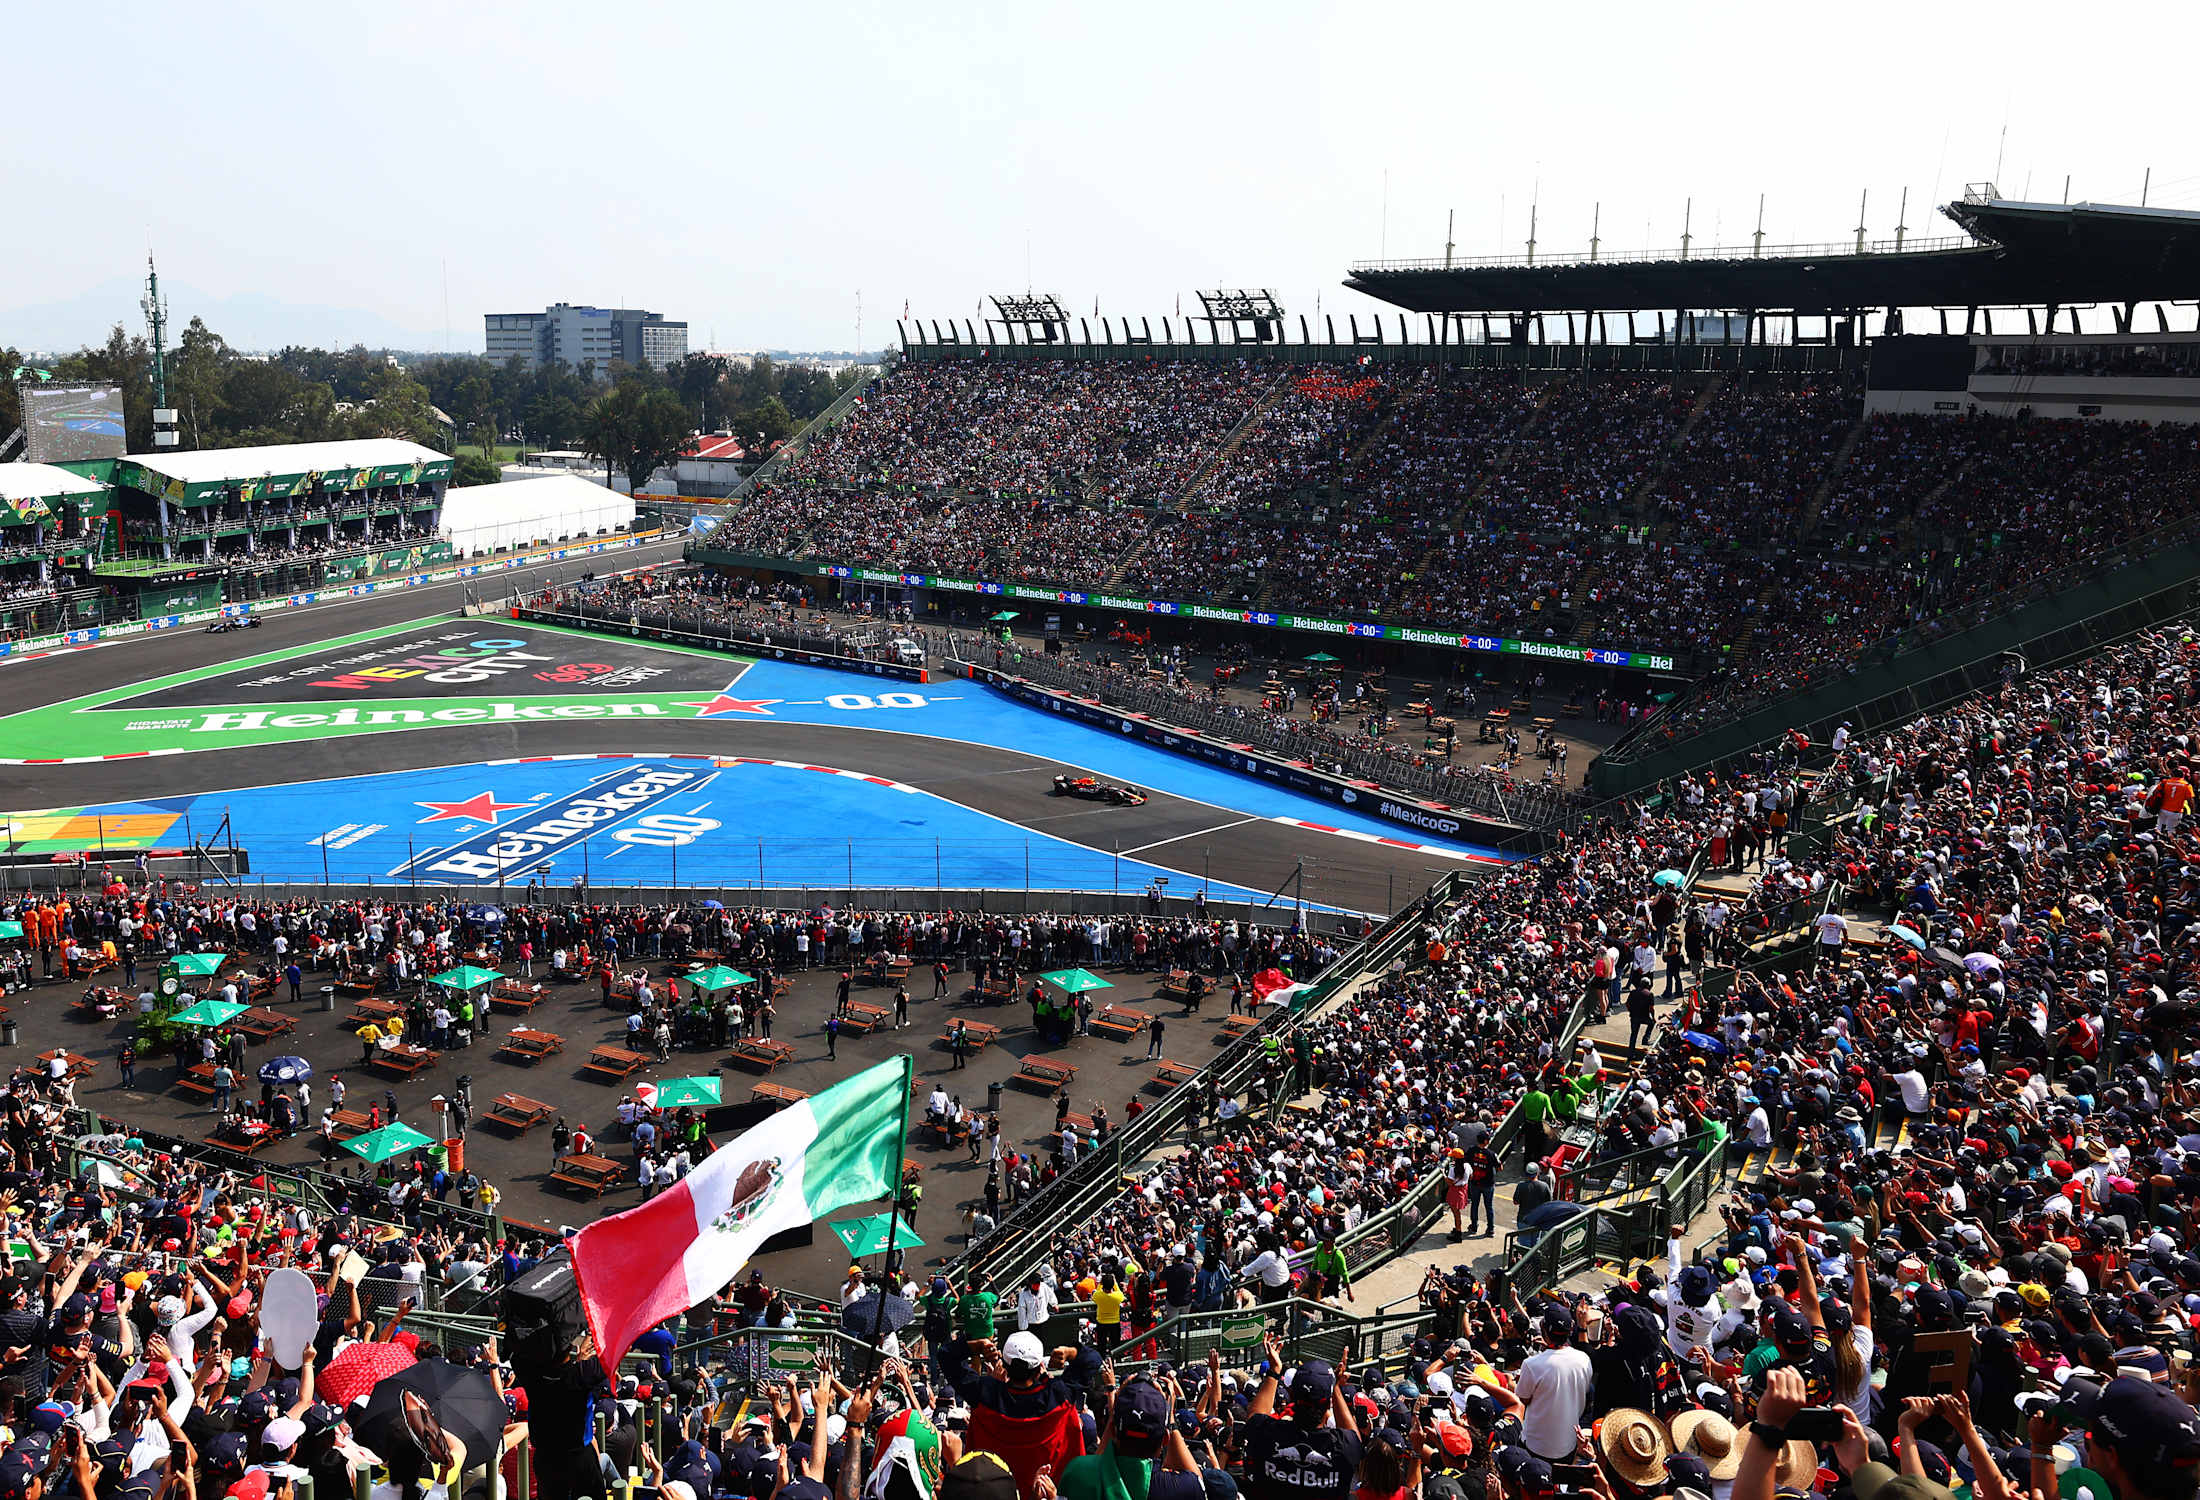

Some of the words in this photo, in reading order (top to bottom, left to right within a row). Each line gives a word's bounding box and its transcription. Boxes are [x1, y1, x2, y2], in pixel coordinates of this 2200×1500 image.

[19, 637, 63, 653] Heineken
[105, 621, 144, 637] Heineken
[183, 611, 218, 625] Heineken
[863, 570, 897, 583] Heineken
[936, 578, 973, 591] Heineken
[1016, 587, 1056, 601] Heineken
[1101, 596, 1144, 611] Heineken
[1193, 606, 1240, 622] Heineken
[1293, 617, 1343, 633] Heineken
[1401, 628, 1457, 646] Heineken
[1520, 641, 1580, 660] Heineken
[1650, 655, 1673, 671] Hei
[306, 639, 528, 690] MEXICO
[424, 650, 554, 683] CITY
[189, 703, 670, 732] Heineken
[424, 771, 696, 879] Heineken
[1379, 801, 1460, 834] #MexicoGP
[1264, 1460, 1301, 1486] Red
[1303, 1470, 1340, 1489] Bull
